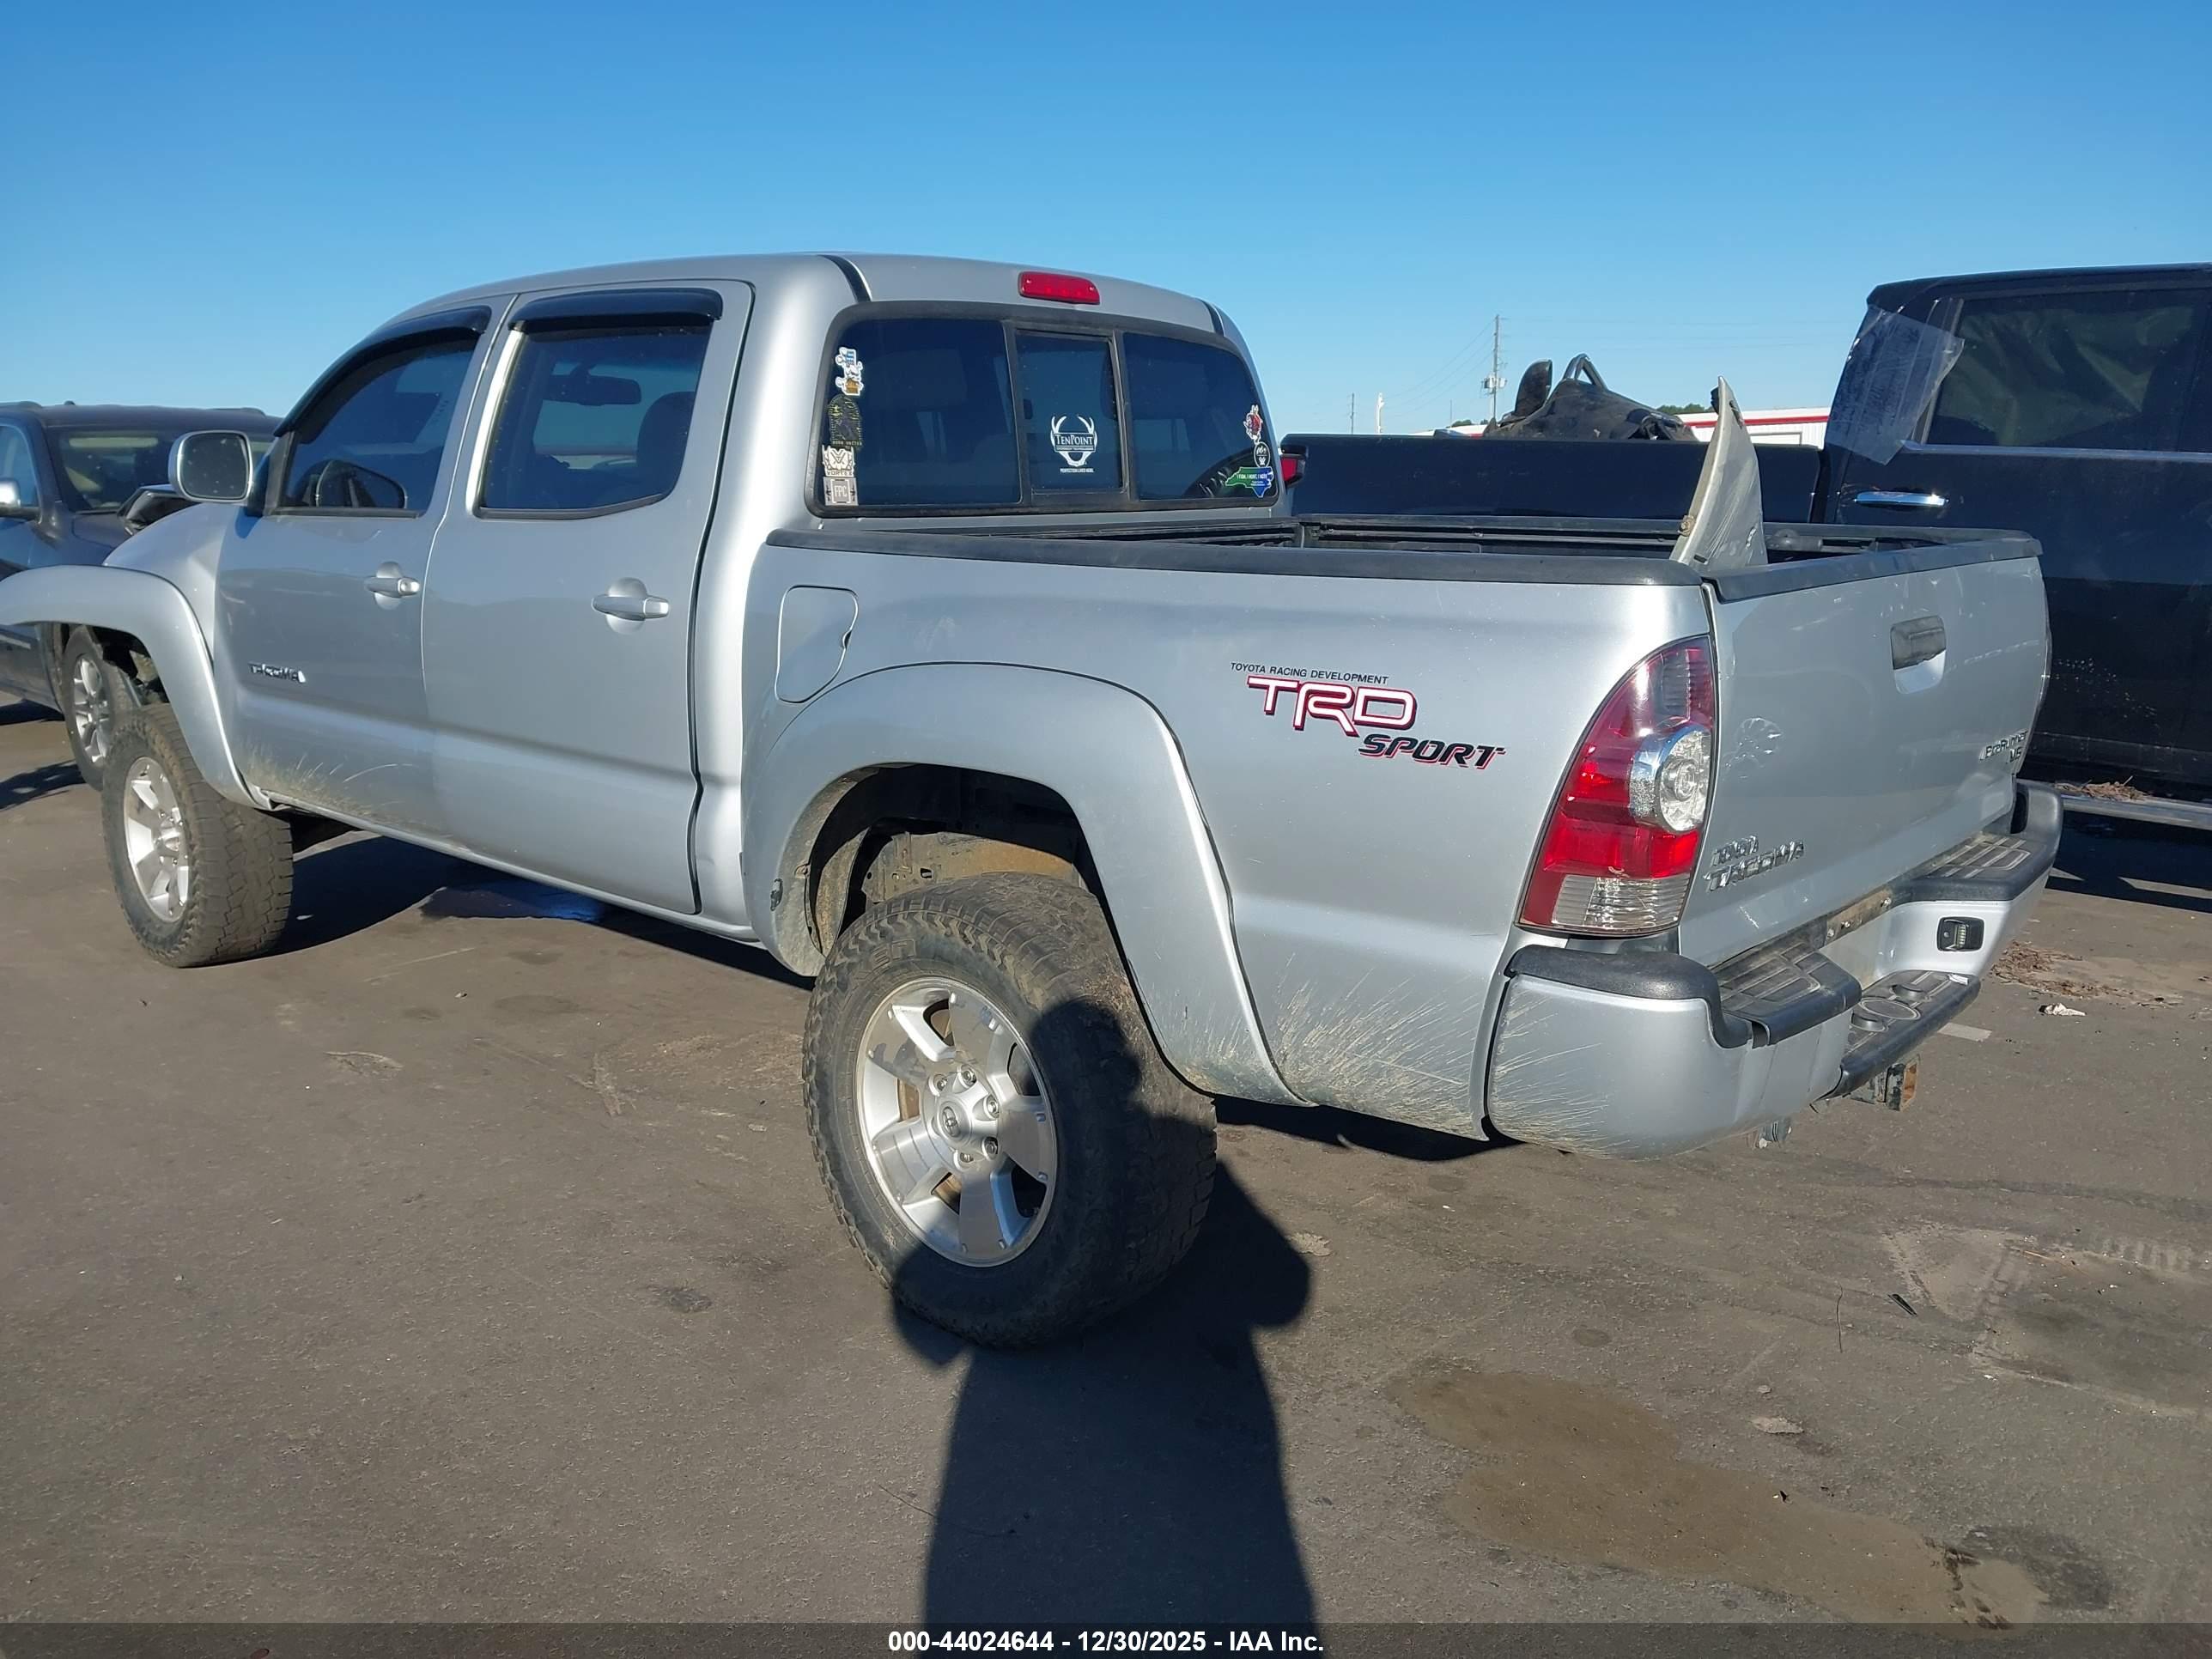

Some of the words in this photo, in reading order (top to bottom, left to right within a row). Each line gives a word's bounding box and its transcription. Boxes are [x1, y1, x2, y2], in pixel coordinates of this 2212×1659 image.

[1231, 662, 1267, 674] TOYOTA
[1269, 666, 1307, 678] RACING
[1310, 670, 1389, 685] DEVELOPMENT
[1246, 674, 1418, 738] TRD
[1358, 733, 1506, 769] SPORT
[1703, 841, 1805, 891] TACOMA
